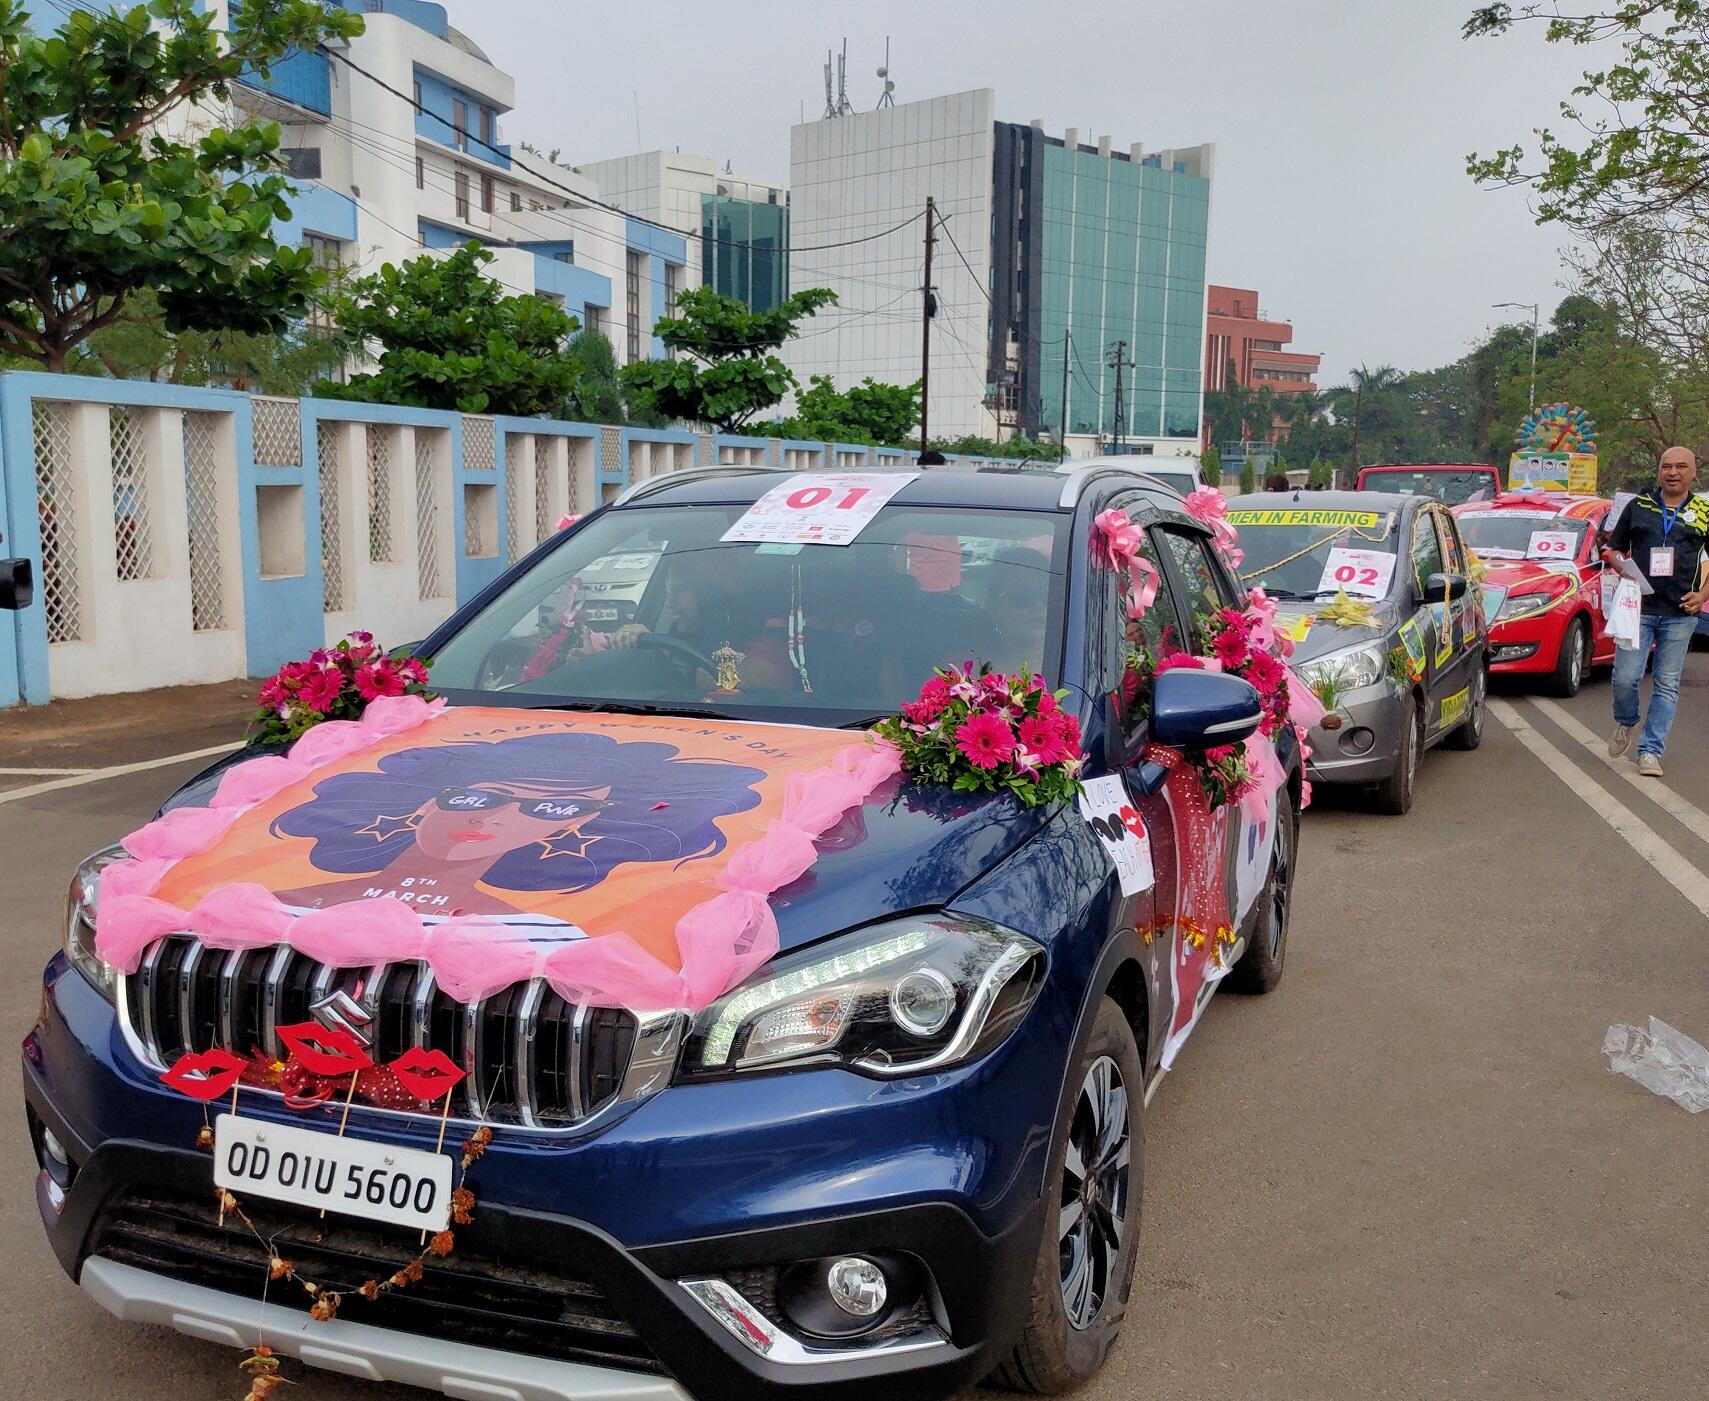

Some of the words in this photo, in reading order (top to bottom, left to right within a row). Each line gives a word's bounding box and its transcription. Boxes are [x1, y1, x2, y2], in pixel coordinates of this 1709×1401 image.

[786, 486, 871, 510] 01
[1224, 511, 1264, 525] MEN
[1265, 511, 1286, 525] IN
[1287, 511, 1370, 526] FARMING
[1536, 541, 1567, 553] 03
[1334, 565, 1379, 587] 02
[462, 721, 578, 738] HAPPY
[600, 722, 744, 742] WOMEN'S
[745, 740, 793, 762] DAY
[448, 794, 487, 809] GRL
[533, 802, 580, 817] PWR
[400, 877, 438, 888] 8TH
[362, 887, 451, 907] MARCH
[228, 1141, 271, 1180] OD
[343, 1164, 438, 1215] 5600
